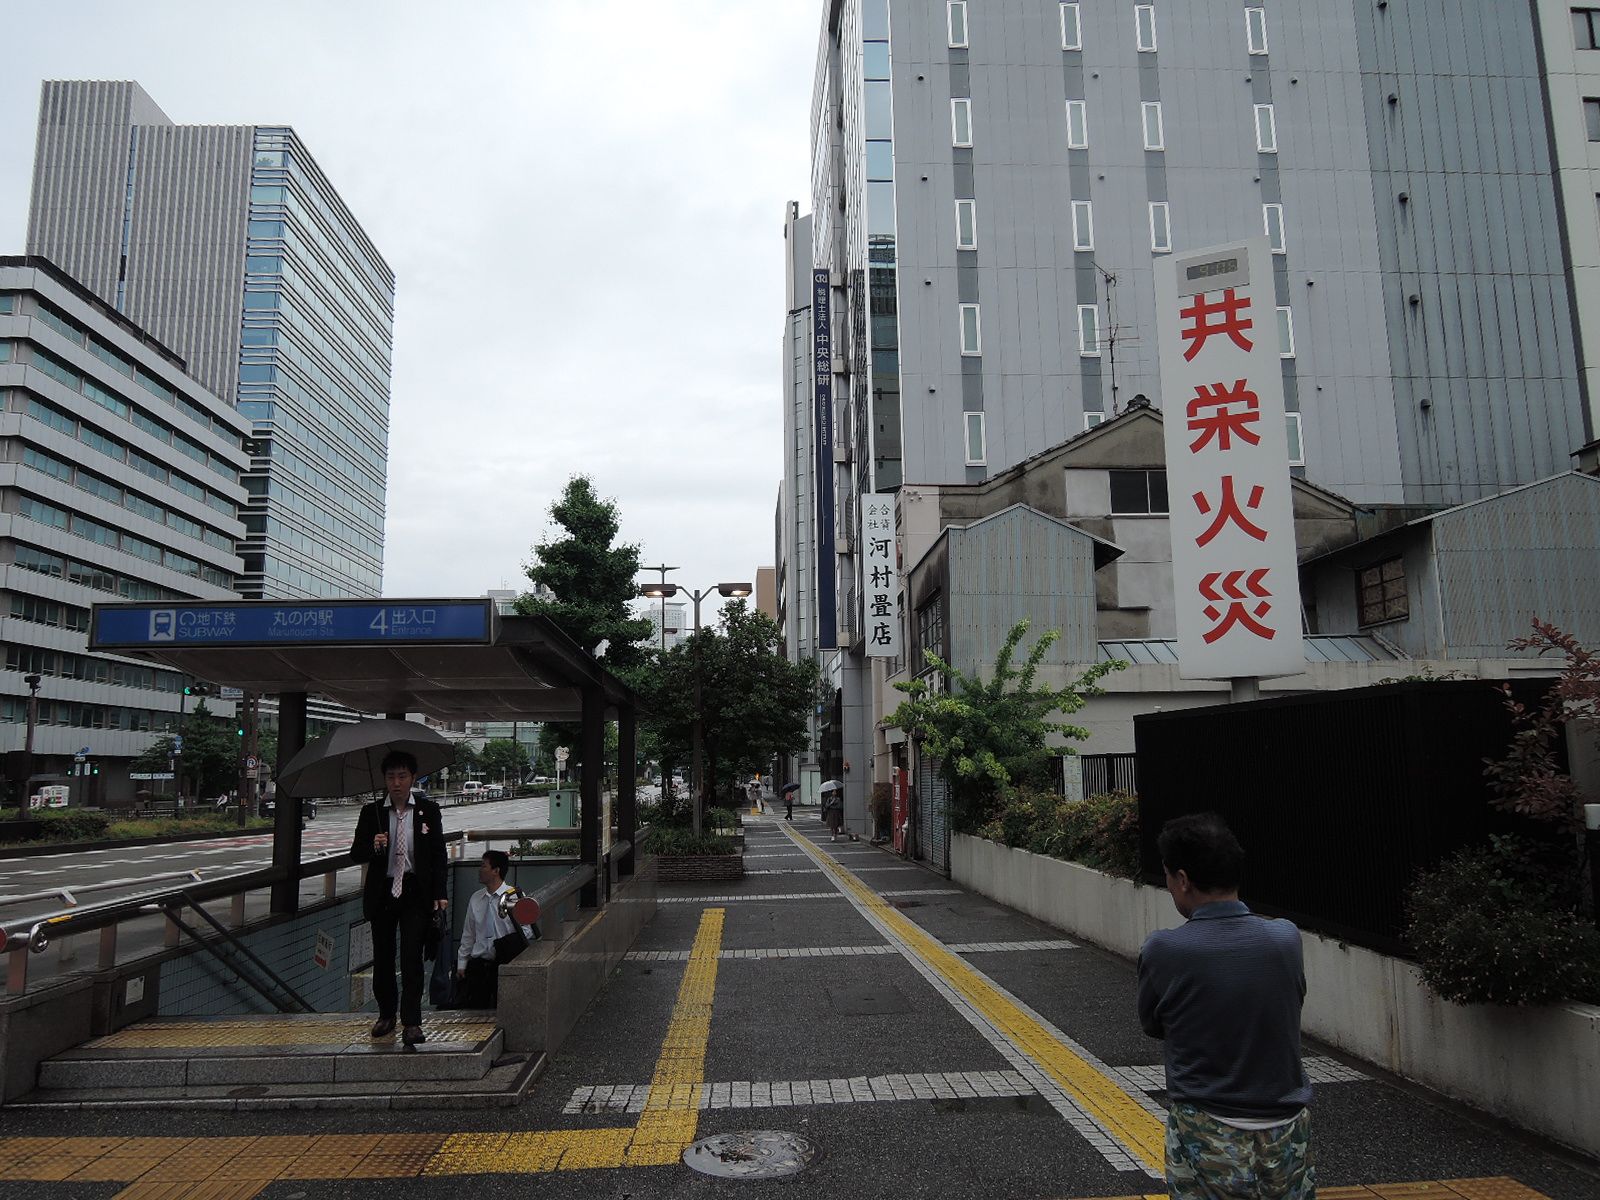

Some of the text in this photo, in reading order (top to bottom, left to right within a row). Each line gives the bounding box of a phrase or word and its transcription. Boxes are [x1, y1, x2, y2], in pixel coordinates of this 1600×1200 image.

[816, 333, 830, 386] 中央総研
[1180, 287, 1276, 646] 共栄火災
[867, 503, 879, 530] 会社
[869, 537, 893, 646] 河村畳店
[197, 611, 237, 626] 地下鉄
[272, 609, 334, 626] 丸の内駅
[369, 608, 388, 635] 4
[391, 609, 437, 625] 出入口
[178, 626, 236, 638] SUBWAY
[391, 626, 433, 636] Entrance
